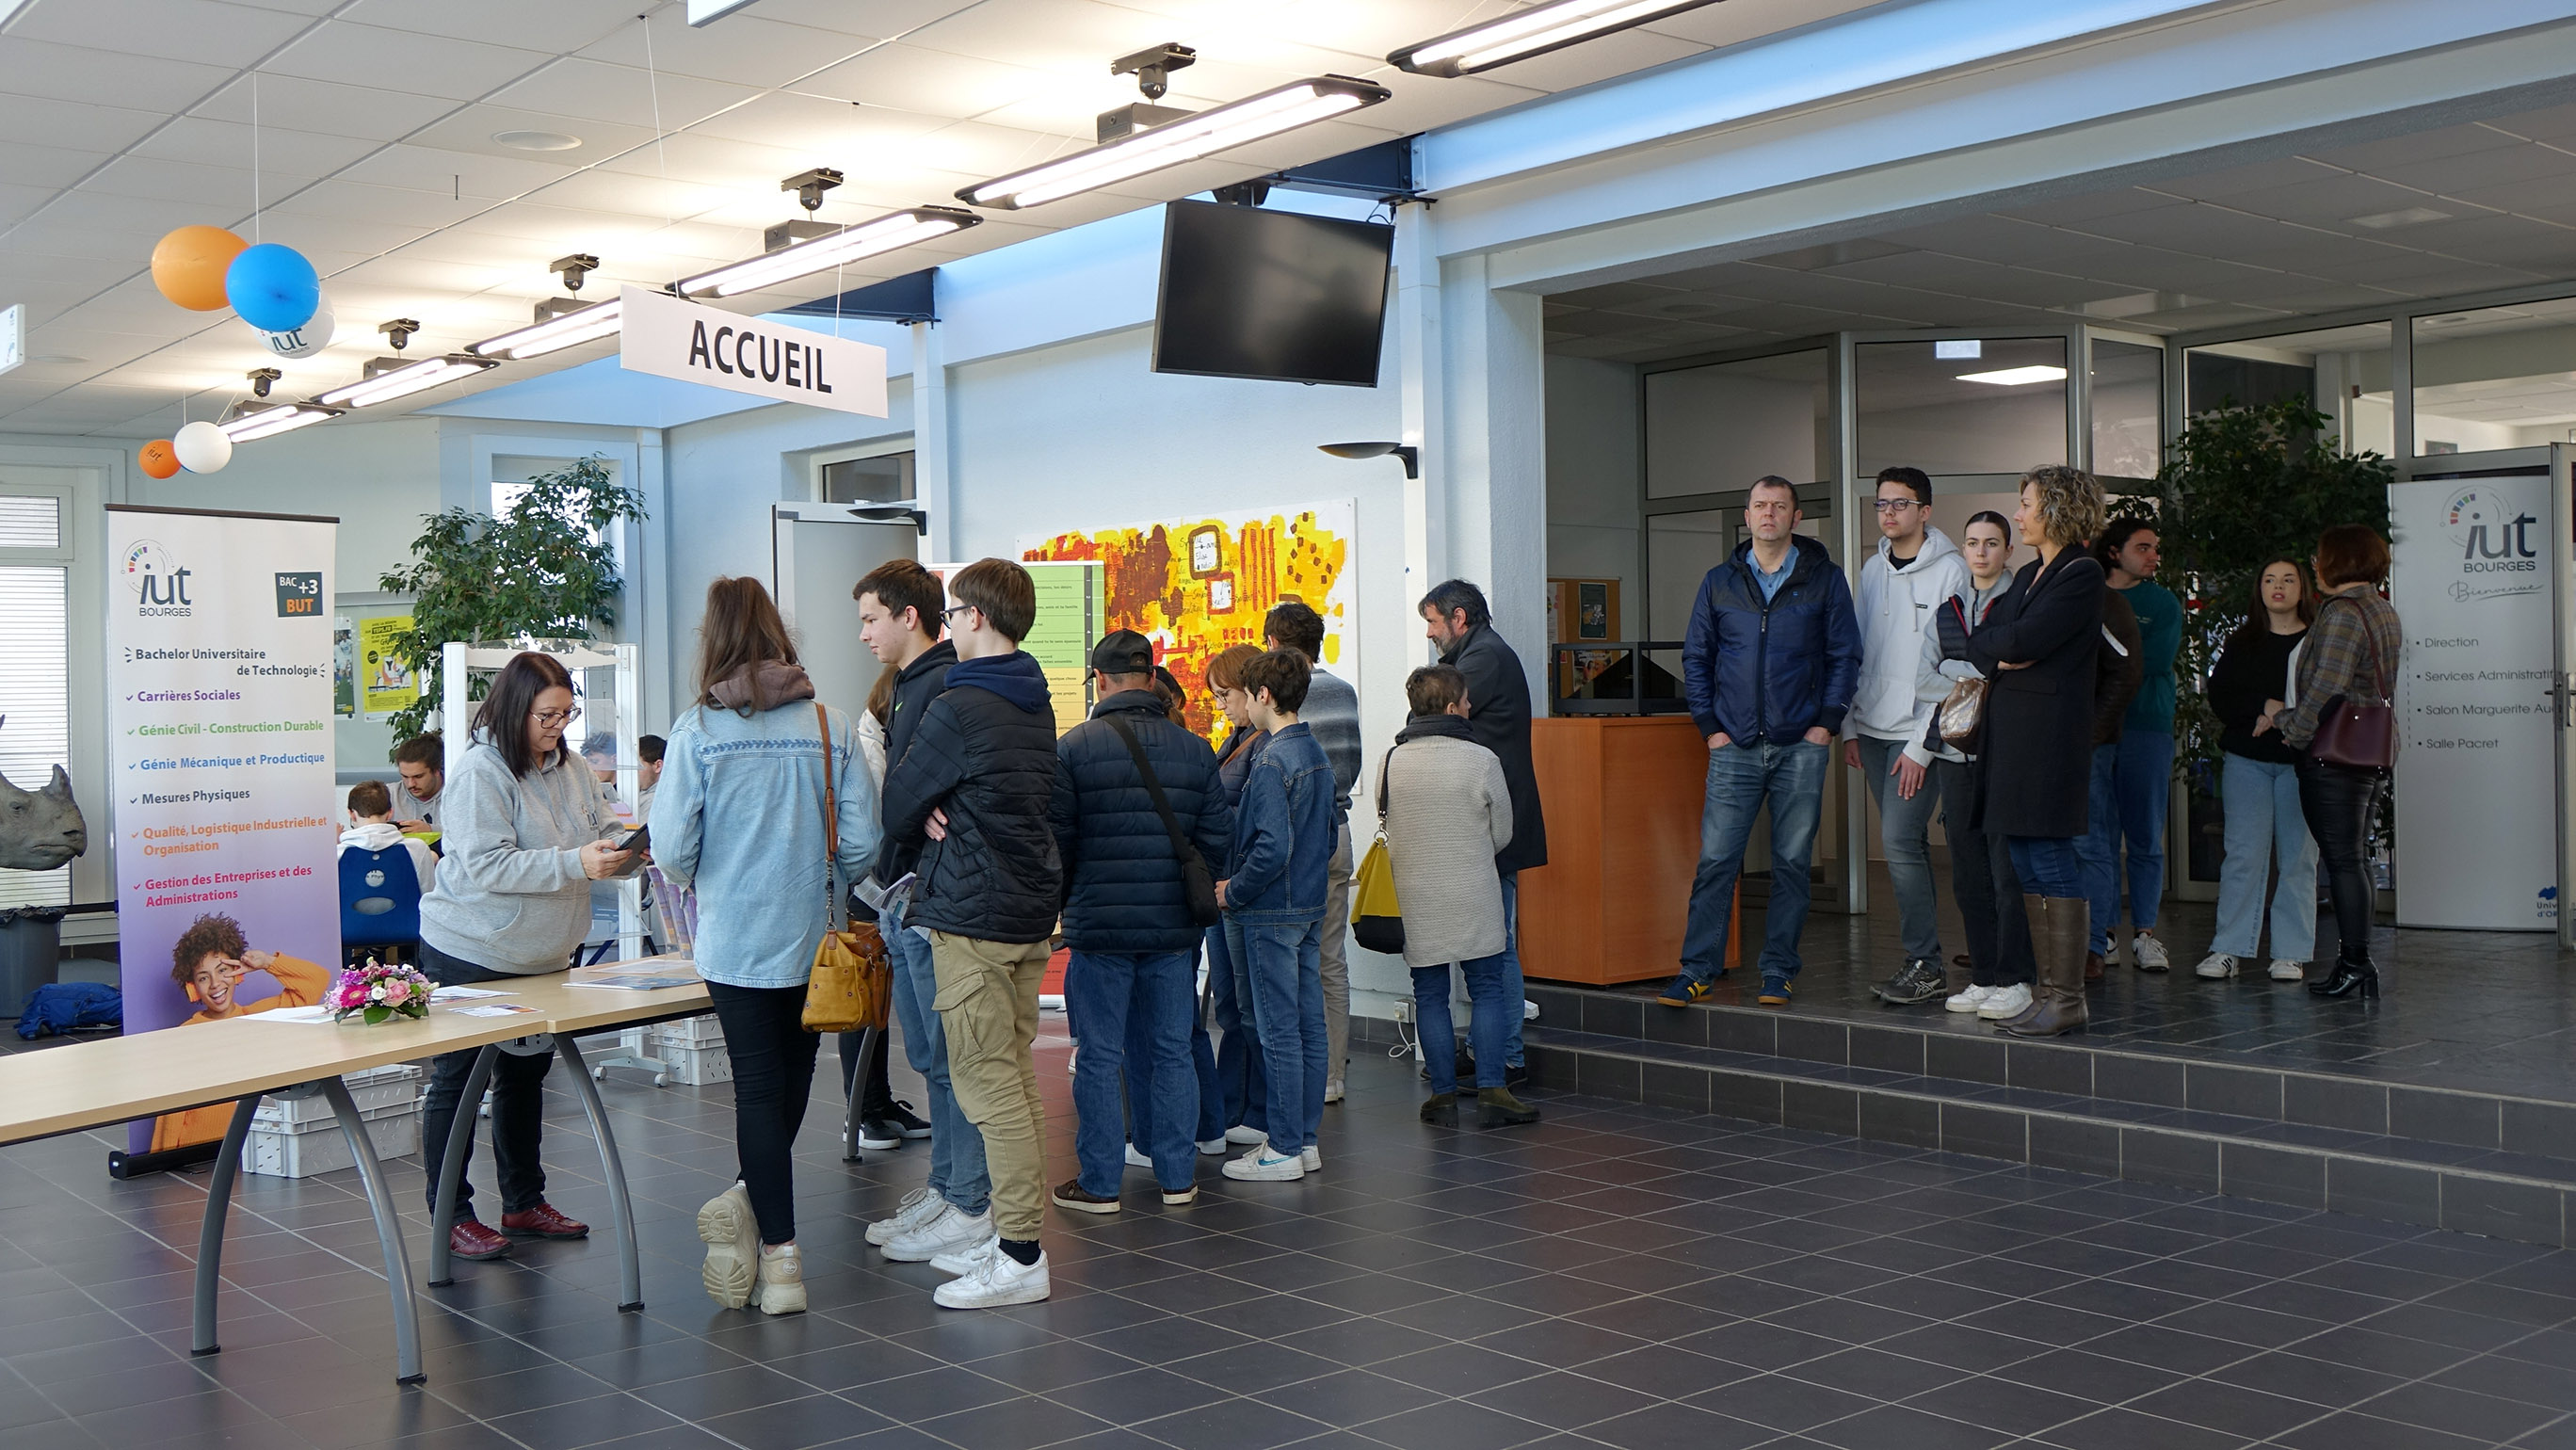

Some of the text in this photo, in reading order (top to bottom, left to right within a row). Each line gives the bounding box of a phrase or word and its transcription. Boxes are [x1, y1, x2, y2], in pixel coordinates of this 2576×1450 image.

[269, 328, 308, 351] iut
[688, 319, 832, 394] ACCUEIL
[2464, 511, 2536, 559] iut
[2464, 560, 2536, 573] BOURGES
[139, 563, 192, 605] iut
[280, 576, 318, 595] BAC +3
[139, 607, 192, 617] BOURGES
[286, 598, 314, 613] BUT
[2424, 637, 2479, 648] Direction
[136, 649, 266, 660] Bachelor Universitaire
[237, 665, 318, 678] de Technologie
[2424, 669, 2554, 682] Services Administratif
[137, 689, 241, 701] Carrières Sociales
[2425, 704, 2554, 717] Salon Marguerite Au
[138, 724, 176, 736] Génie
[178, 723, 201, 734] Civil
[209, 721, 282, 733] Construction
[284, 720, 324, 732] Durable
[2426, 738, 2499, 749] Salle Pacret
[140, 752, 325, 770] Génie Mécanique et Productique
[142, 789, 250, 805] Mesures Physiques
[143, 816, 328, 840] Qualité, Logistique Industrielle et
[144, 841, 219, 858] Organisation
[145, 866, 312, 891] Gestion des Entreprises et des
[146, 890, 238, 908] Administrations
